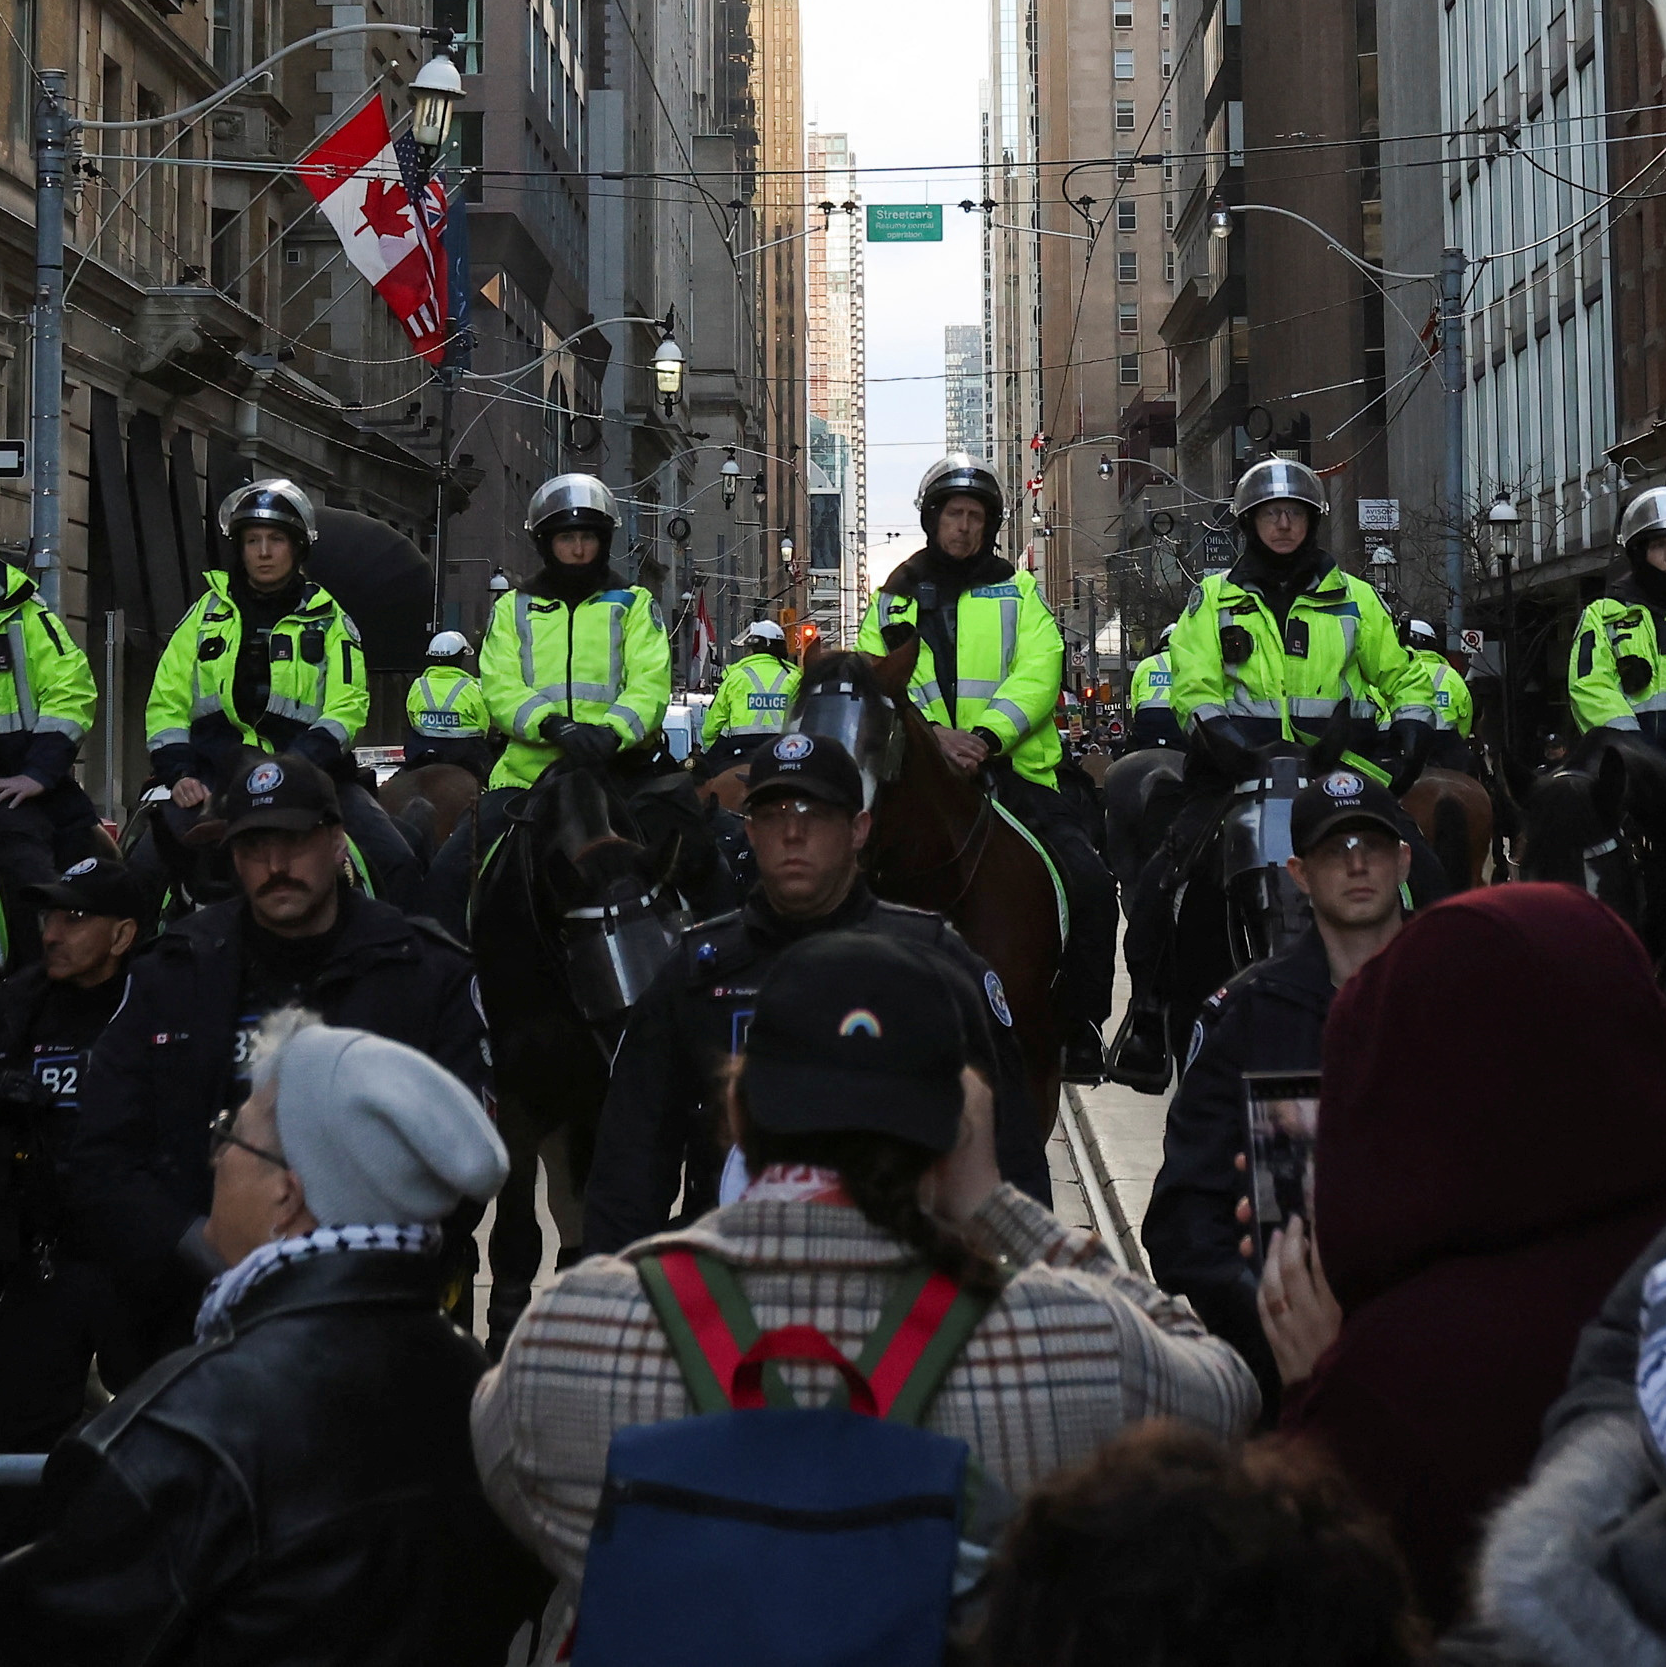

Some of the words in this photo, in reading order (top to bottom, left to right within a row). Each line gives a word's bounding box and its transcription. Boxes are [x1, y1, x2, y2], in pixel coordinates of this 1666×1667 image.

[876, 209, 933, 220] Streetcars
[748, 696, 787, 708] POLICE
[421, 713, 459, 725] POLICE
